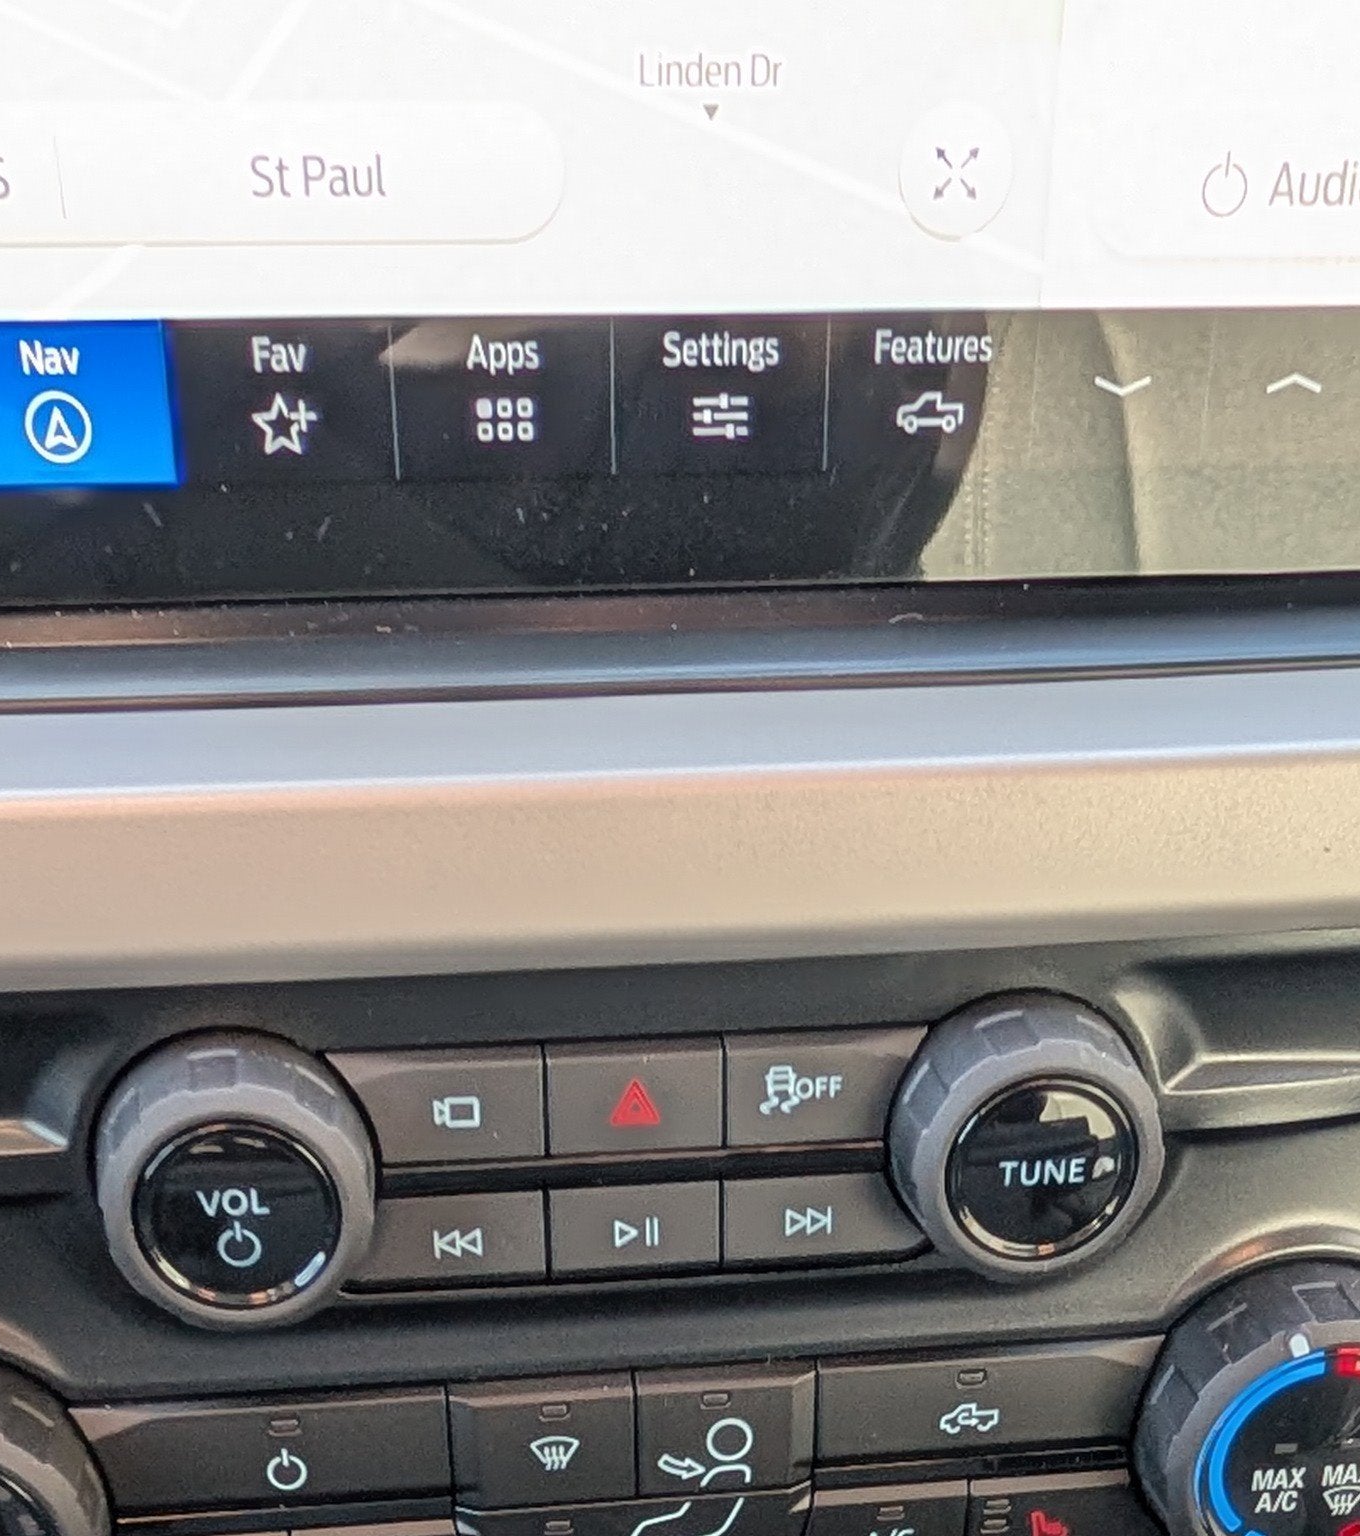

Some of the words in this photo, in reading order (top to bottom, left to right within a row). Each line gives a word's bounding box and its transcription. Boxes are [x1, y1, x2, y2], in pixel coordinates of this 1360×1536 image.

[639, 54, 742, 88] Linden
[750, 54, 783, 88] Dr
[250, 156, 290, 198] St
[303, 154, 387, 198] Paul
[19, 340, 81, 376] Nav
[251, 337, 307, 374] Fav
[466, 334, 540, 377] Apps
[662, 330, 780, 374] Settings
[873, 328, 993, 365] Features
[796, 1074, 843, 1100] OFF
[998, 1157, 1087, 1187] TUNE
[196, 1188, 270, 1218] VOL
[1250, 1467, 1305, 1491] MAX
[1254, 1488, 1299, 1514] A/C
